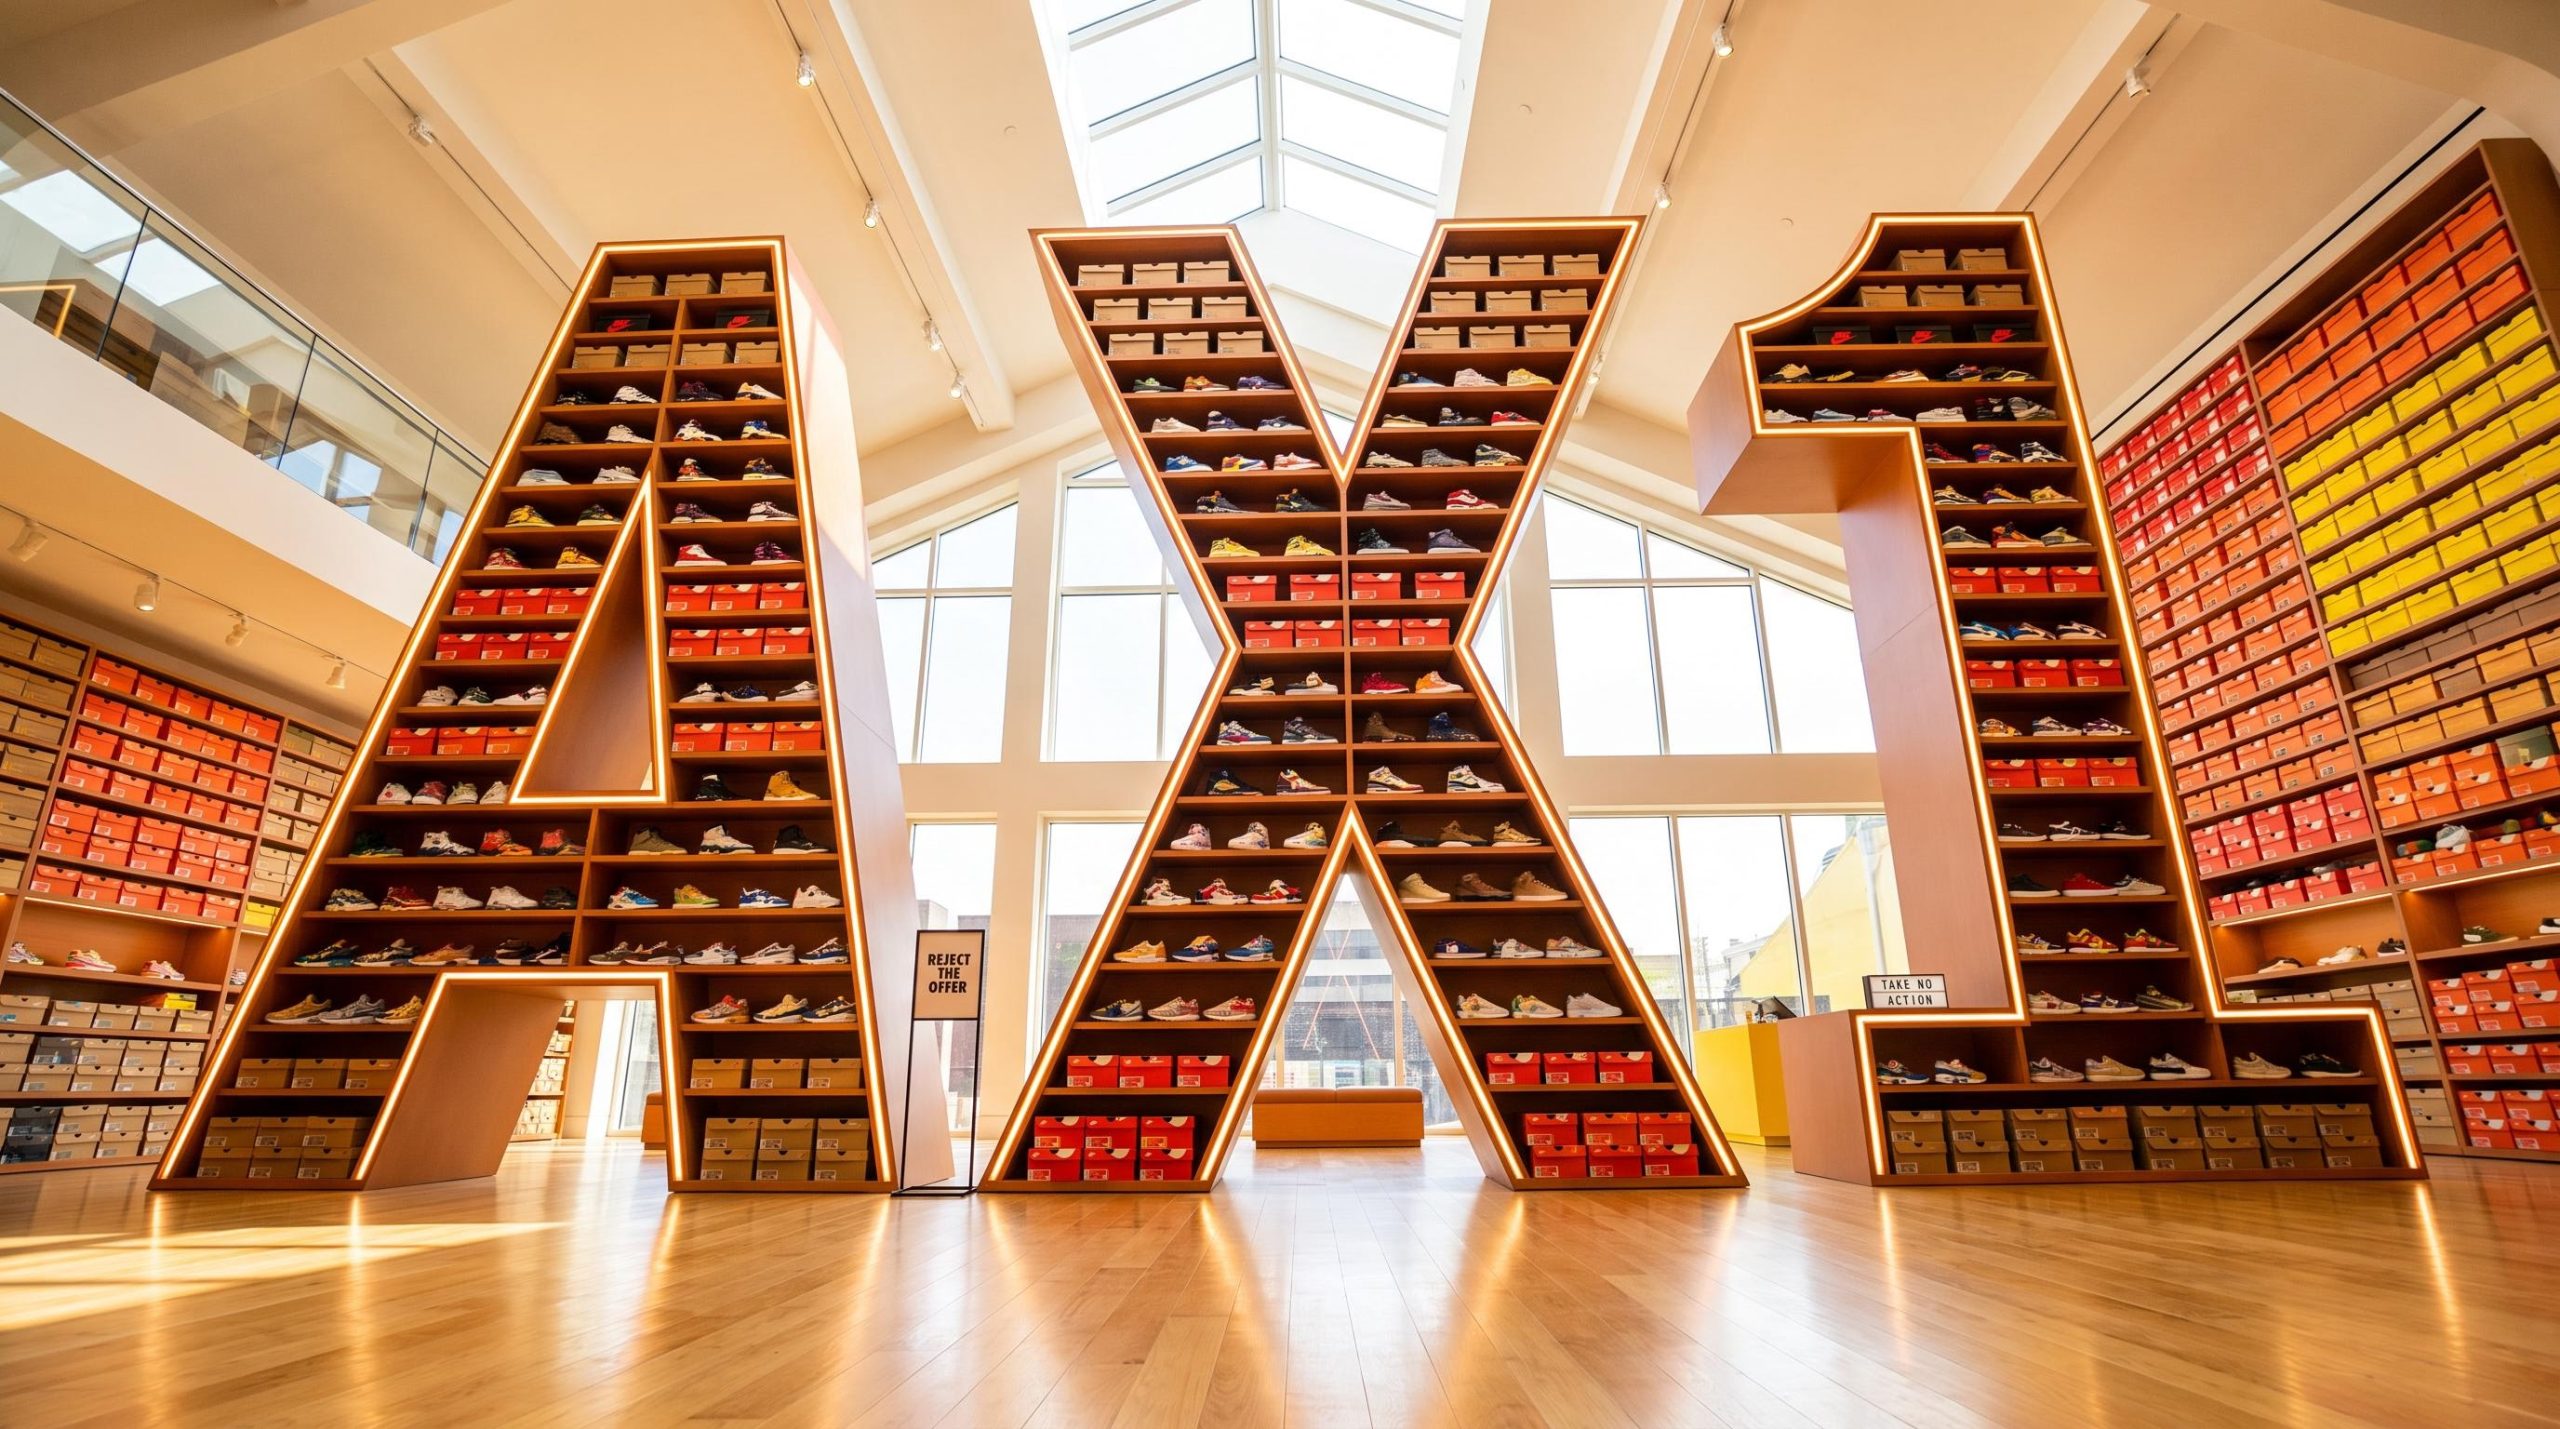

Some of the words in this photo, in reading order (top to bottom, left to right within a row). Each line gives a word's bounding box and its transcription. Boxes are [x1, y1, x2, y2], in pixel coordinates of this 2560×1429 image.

[927, 953, 971, 966] REJECT
[937, 967, 961, 980] THE
[928, 981, 967, 994] OFFER
[1881, 979, 1910, 990] TAKE
[1917, 978, 1933, 989] NO
[1888, 995, 1933, 1006] ACTION
